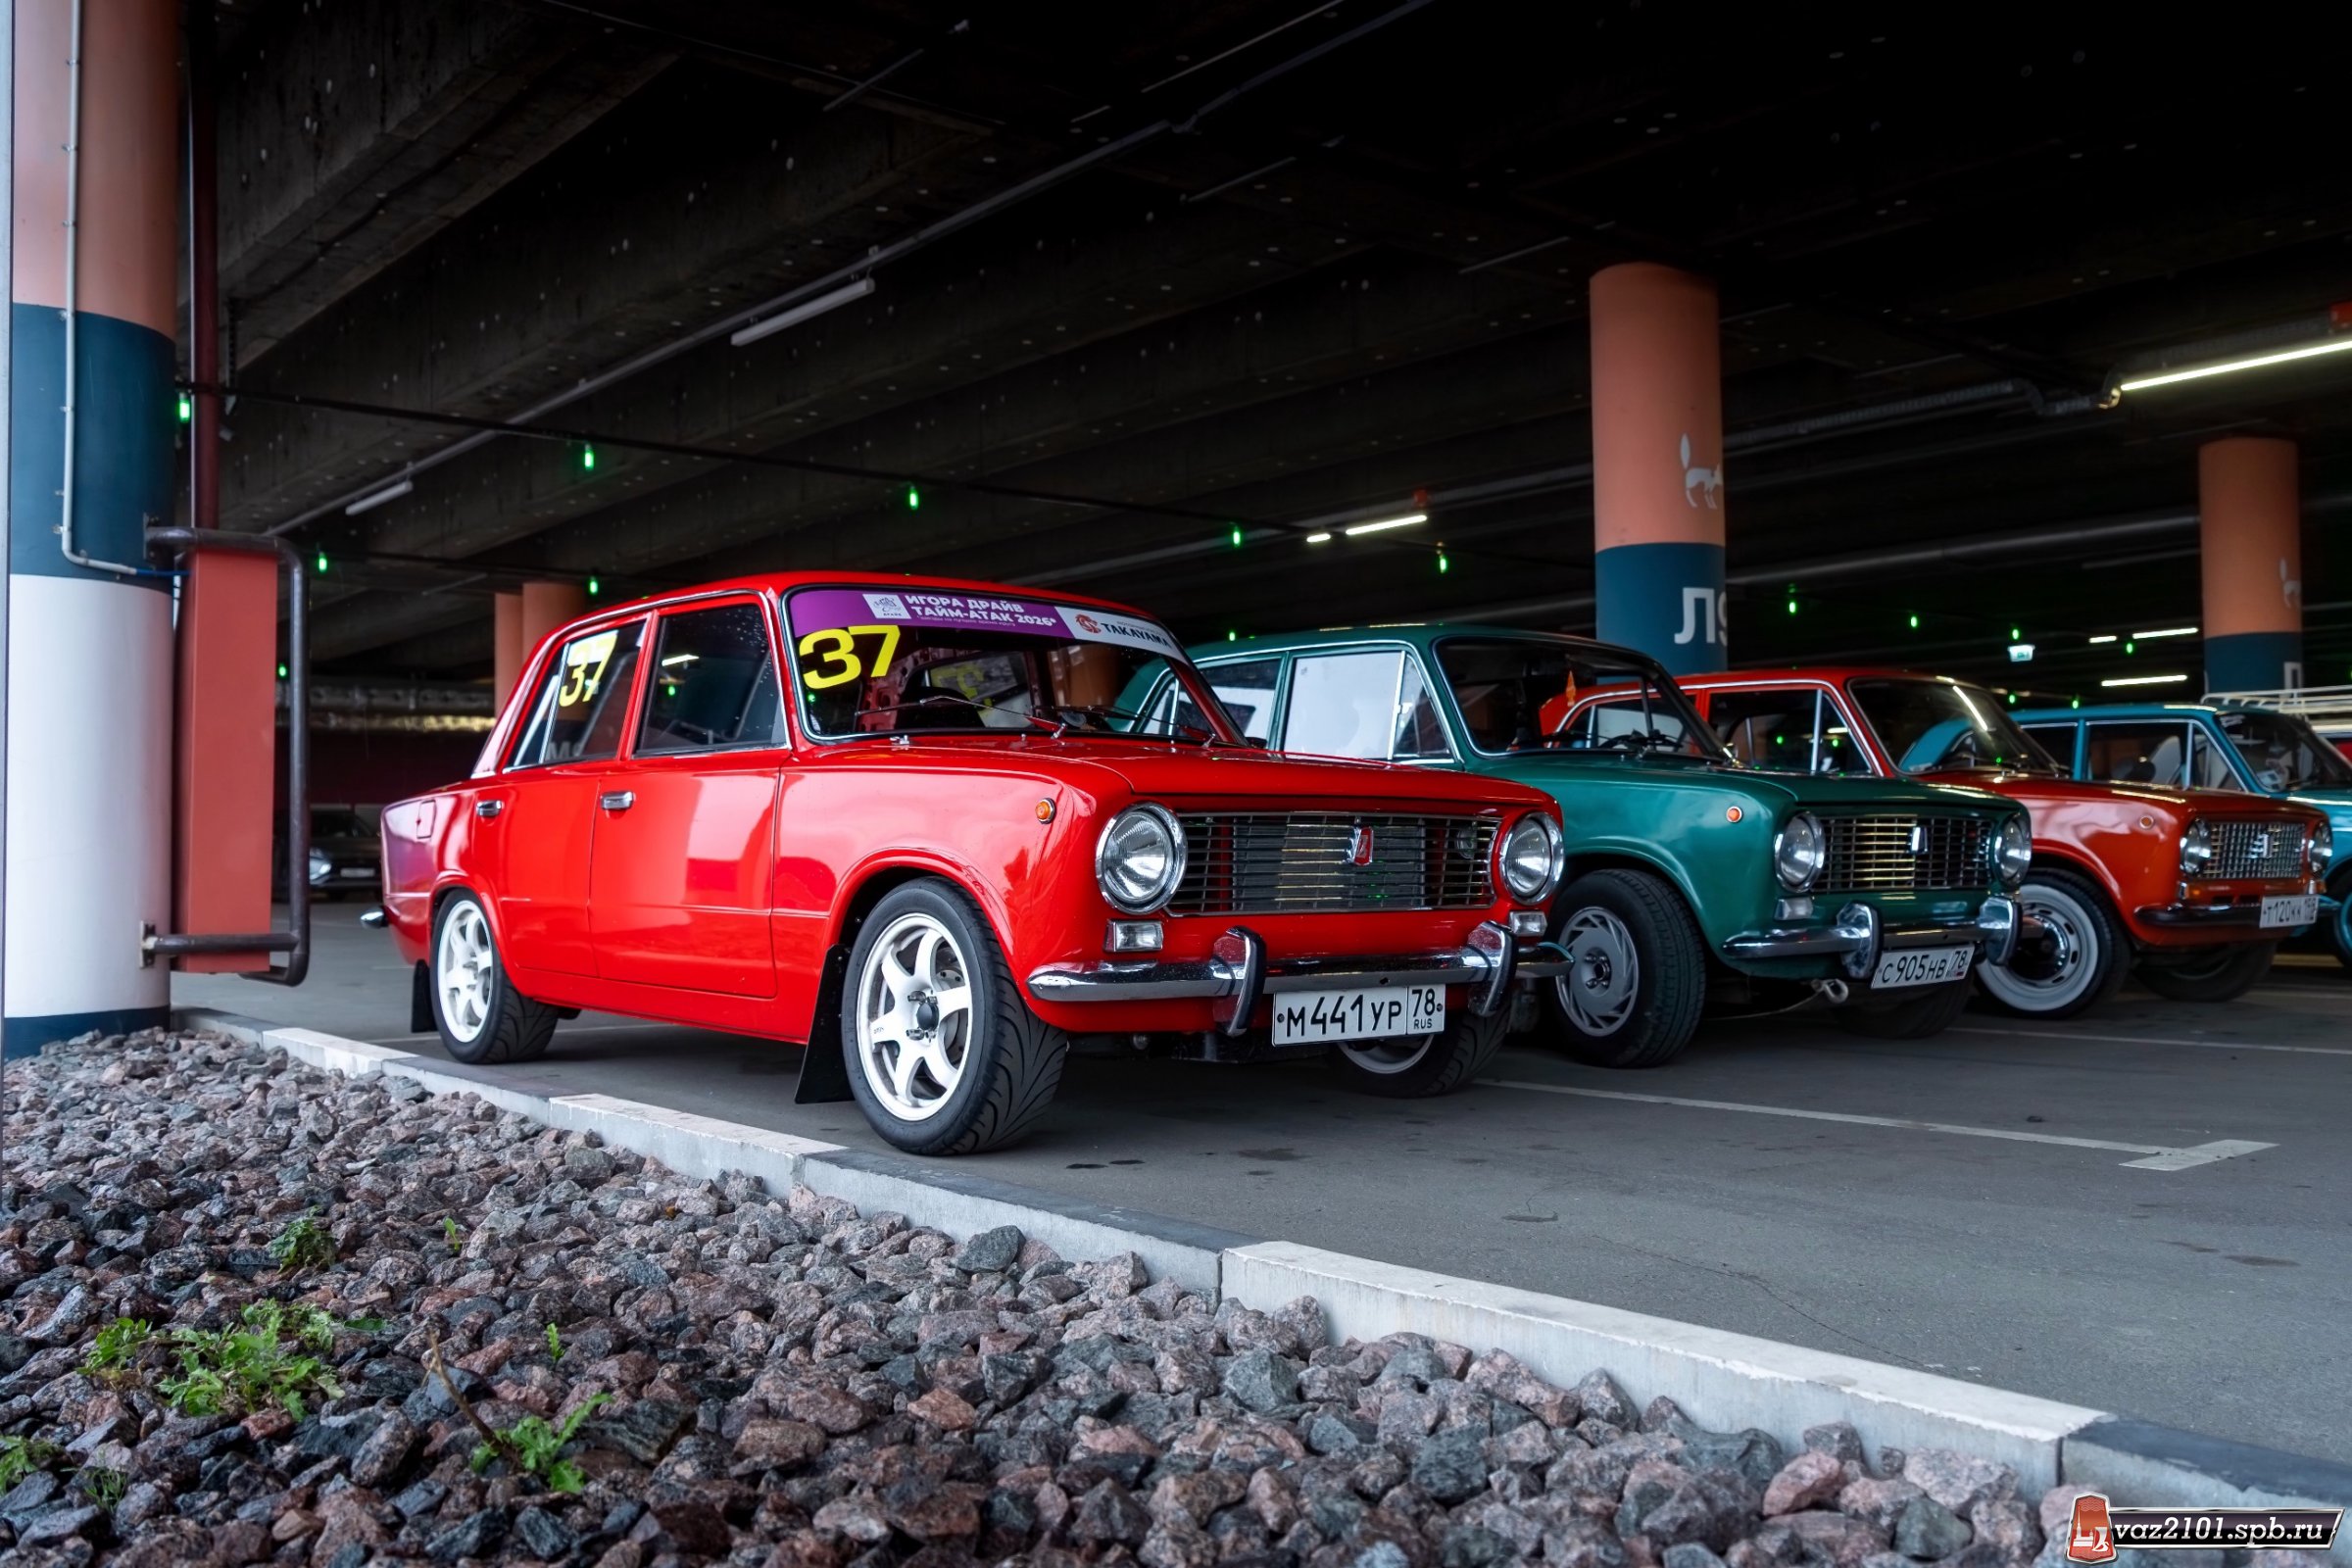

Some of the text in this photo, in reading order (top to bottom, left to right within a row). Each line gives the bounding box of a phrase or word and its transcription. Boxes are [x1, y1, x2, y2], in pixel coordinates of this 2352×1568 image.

[905, 595, 1025, 613] ИГОРА ДРАЙВ
[910, 605, 1014, 622] ТАЙМ-АТАК
[1101, 622, 1173, 649] TAKAYAMA
[559, 633, 617, 708] 37
[800, 625, 901, 689] 37
[1882, 955, 1947, 983] С905НВ
[1287, 988, 1436, 1038] М441УР 78
[1414, 1018, 1433, 1029] RUS
